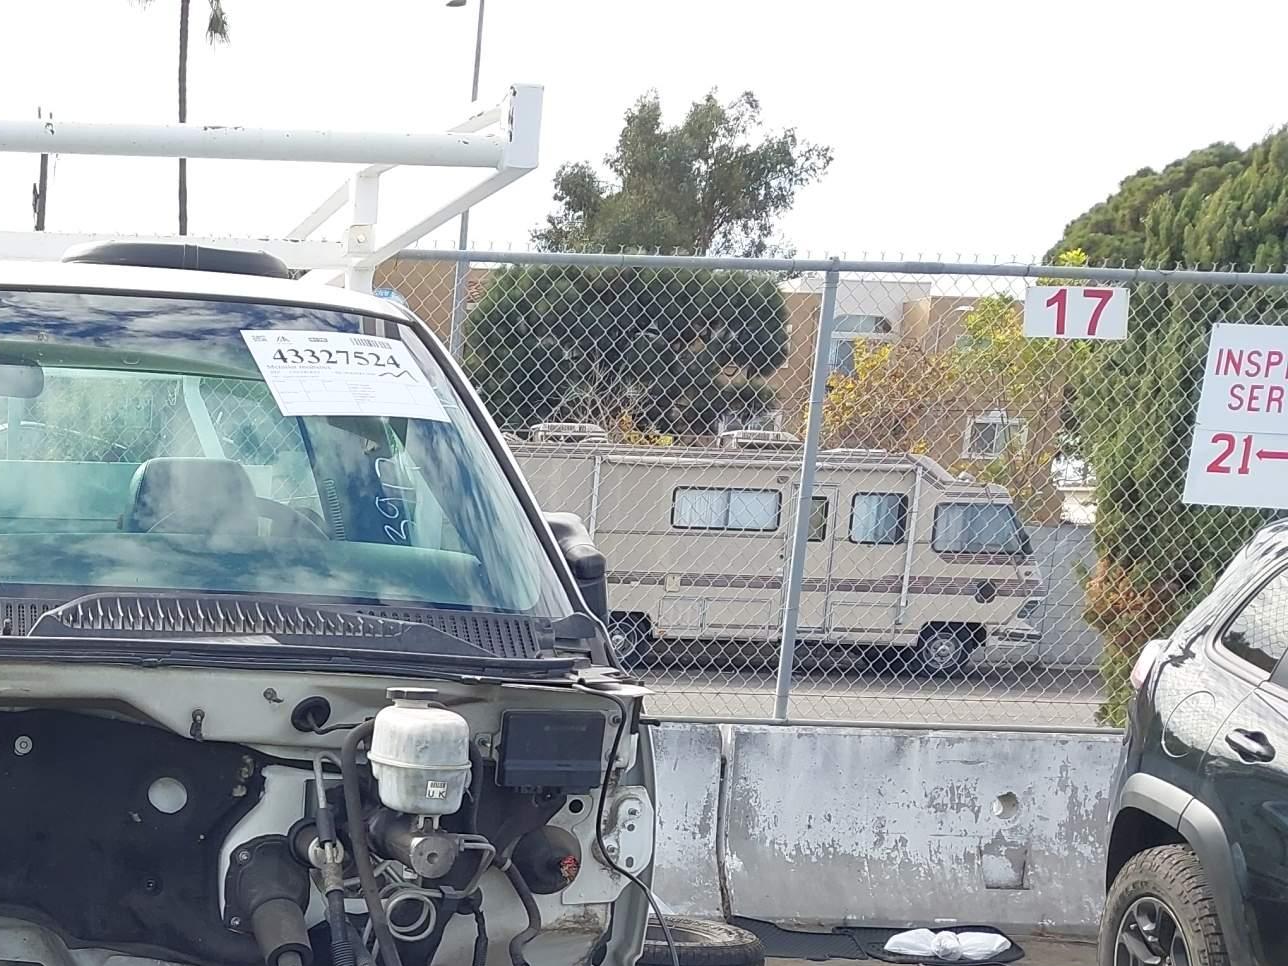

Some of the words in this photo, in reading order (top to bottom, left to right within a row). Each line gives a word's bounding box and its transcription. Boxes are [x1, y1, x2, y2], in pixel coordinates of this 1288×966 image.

[1046, 288, 1114, 337] 17
[272, 347, 401, 369] 43327524
[1215, 347, 1288, 380] INSP
[1206, 432, 1253, 475] 21
